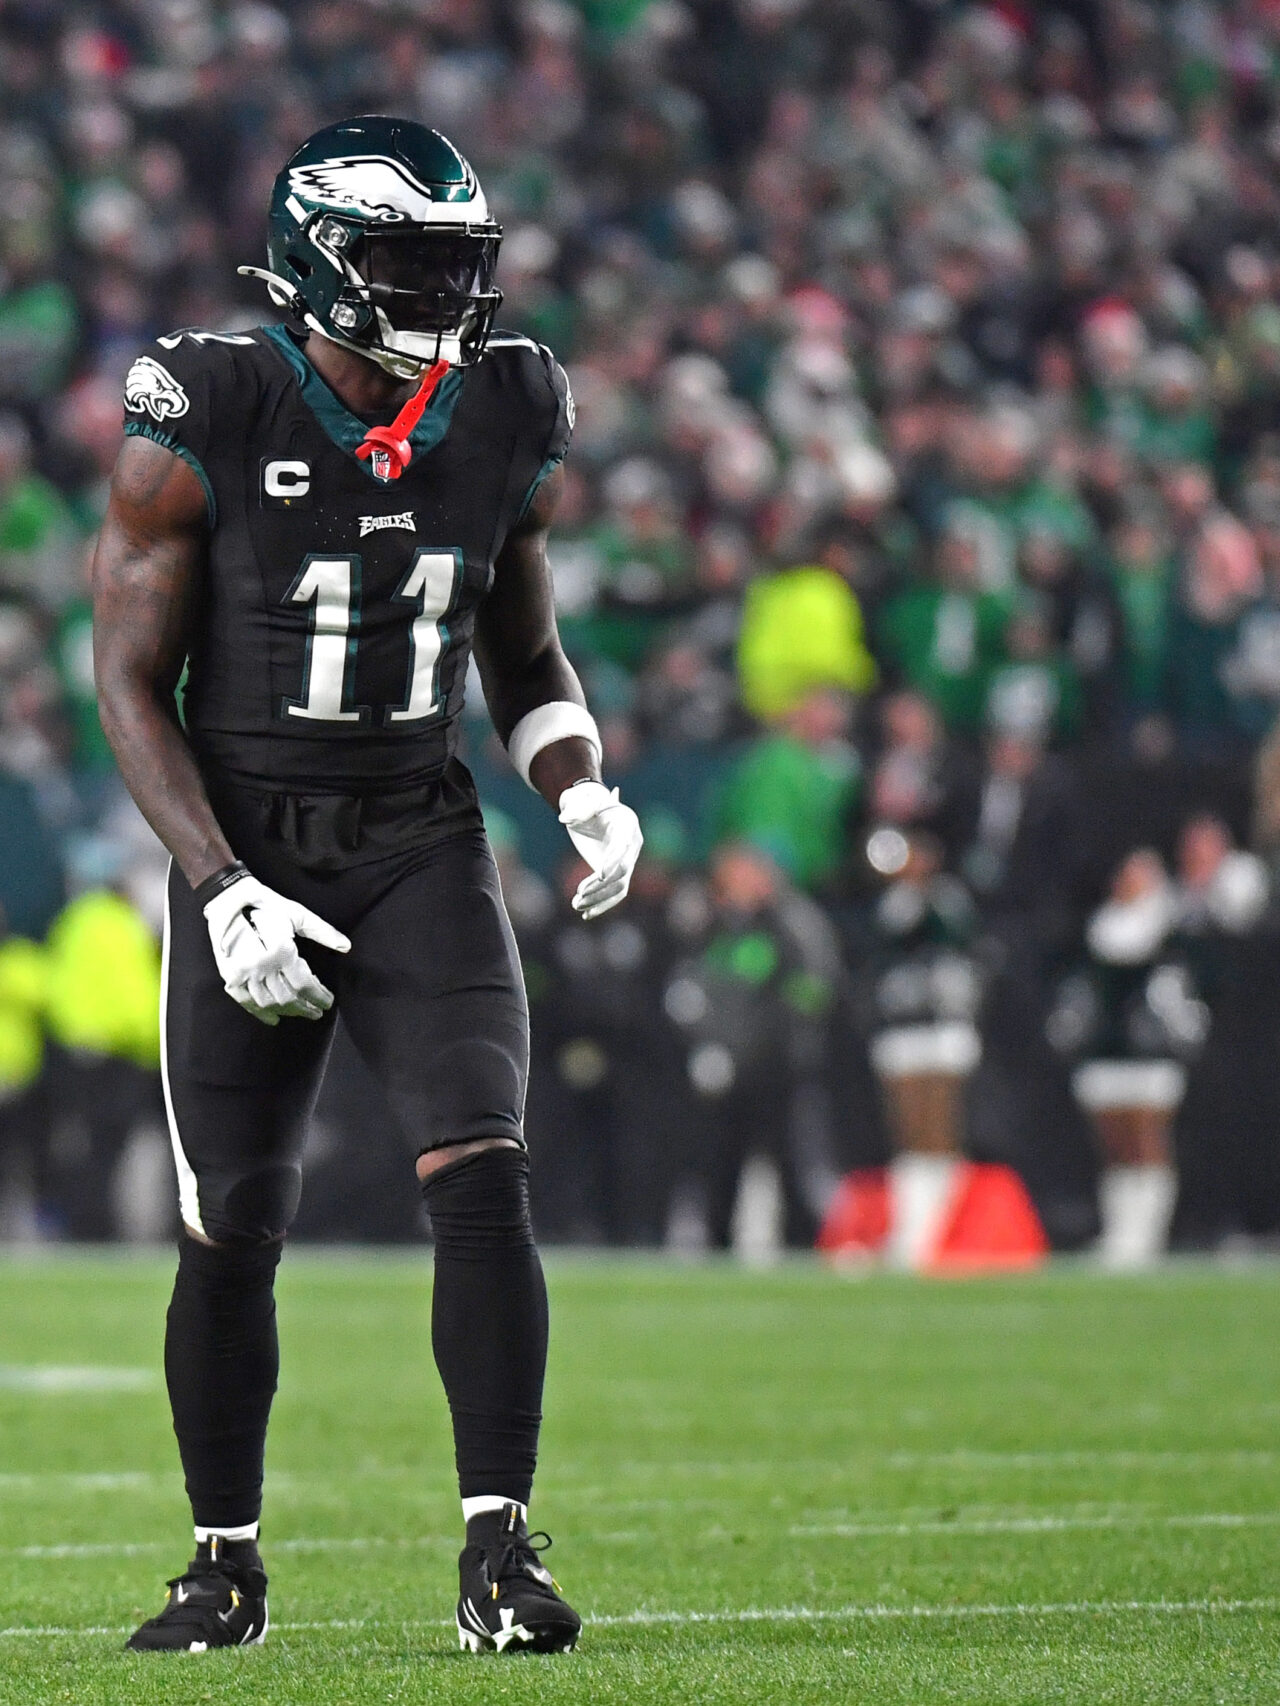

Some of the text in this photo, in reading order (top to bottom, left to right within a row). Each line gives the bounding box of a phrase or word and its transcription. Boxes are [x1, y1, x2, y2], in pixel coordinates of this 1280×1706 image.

[264, 459, 311, 498] C
[357, 511, 417, 538] EAGLES
[284, 552, 460, 724] 11
